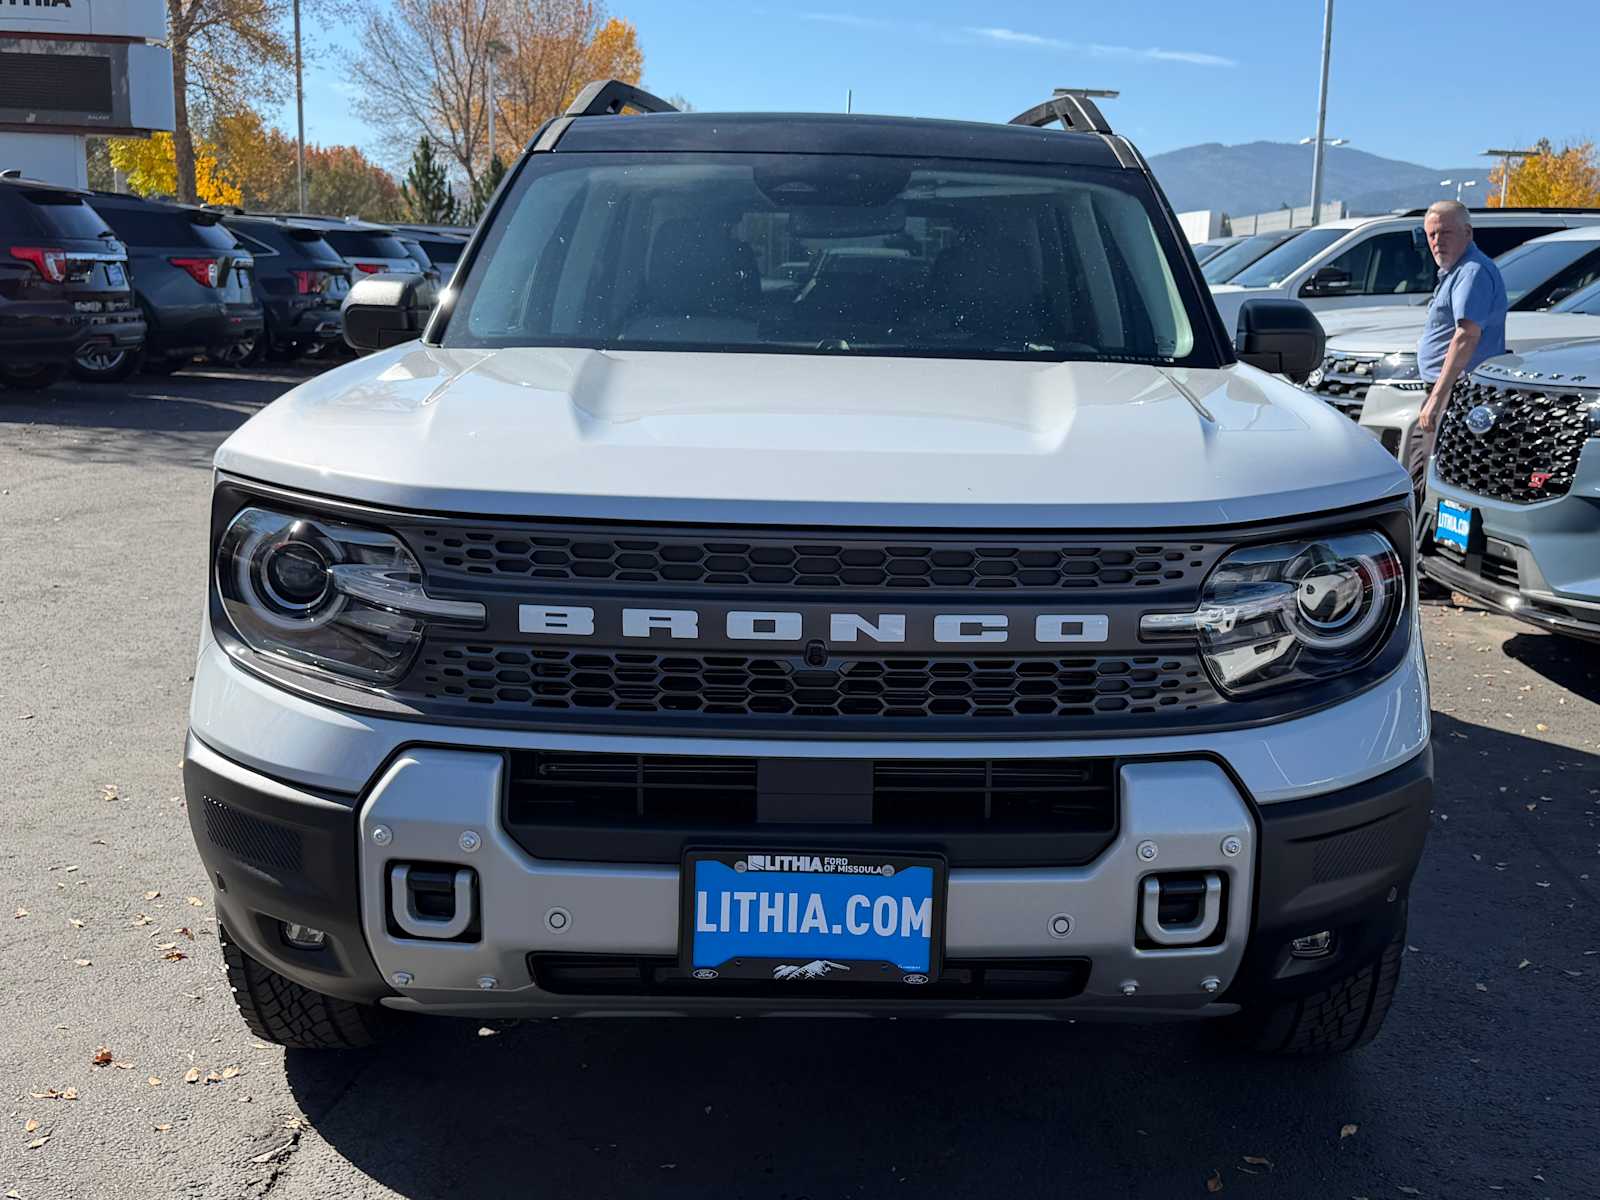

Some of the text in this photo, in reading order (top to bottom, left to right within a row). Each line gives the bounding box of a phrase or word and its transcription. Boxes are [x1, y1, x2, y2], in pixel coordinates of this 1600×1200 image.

[519, 604, 1109, 643] BRONCO
[765, 855, 823, 872] LITHIA
[824, 857, 848, 865] FORD
[837, 865, 883, 874] MISSOULA
[696, 891, 933, 938] LITHIA.COM
